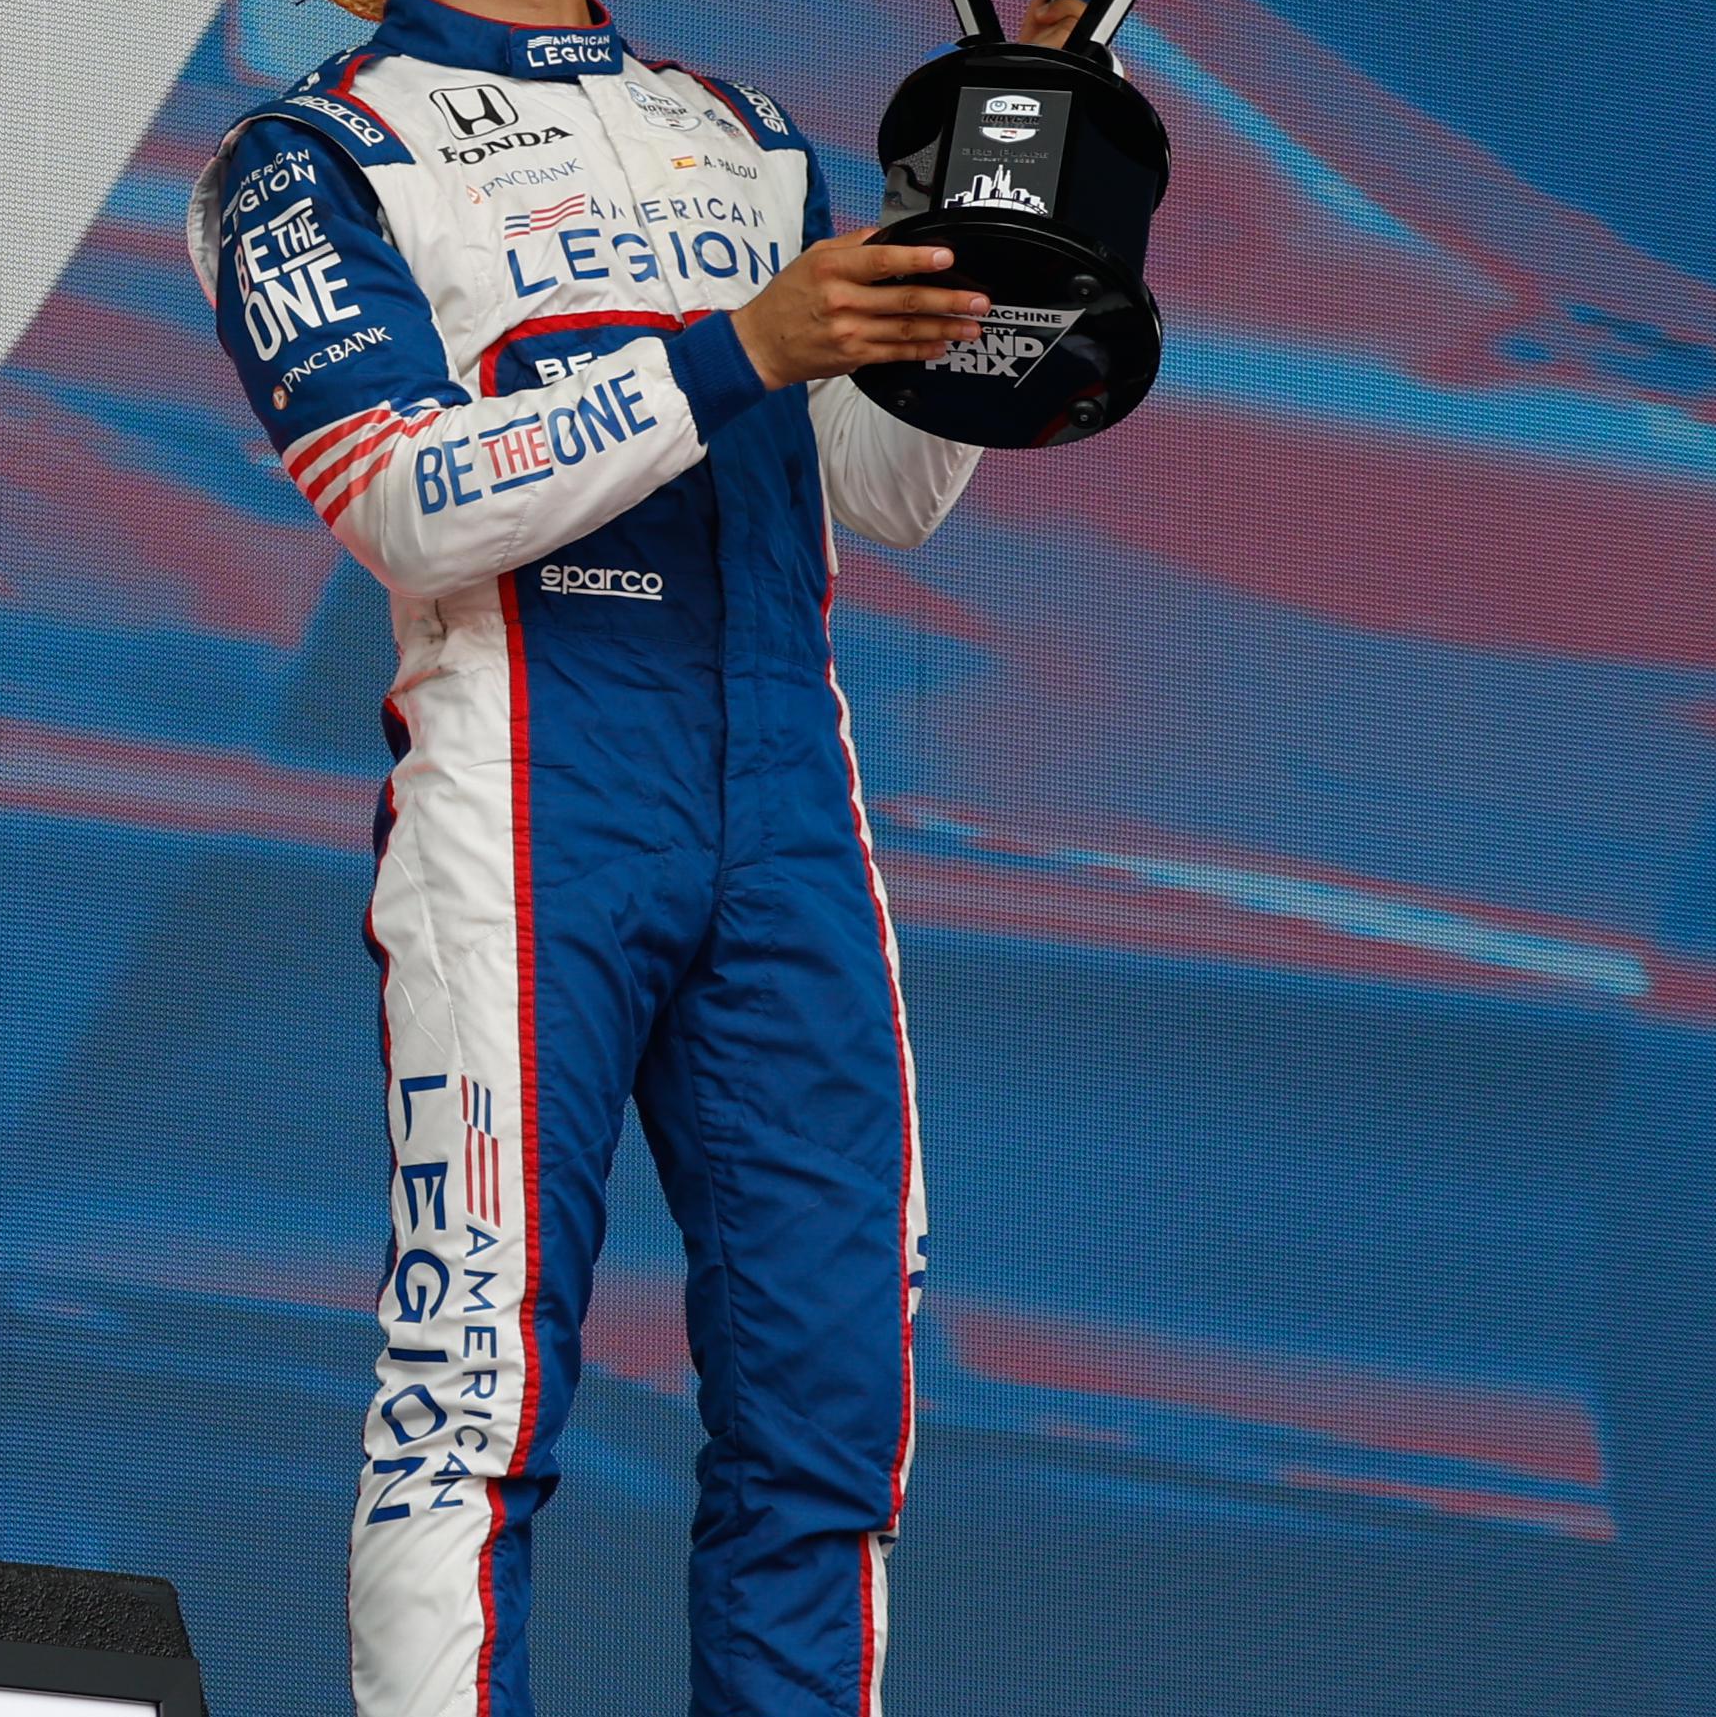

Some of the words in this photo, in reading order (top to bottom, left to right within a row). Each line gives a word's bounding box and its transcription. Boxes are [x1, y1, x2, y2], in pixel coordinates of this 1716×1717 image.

[552, 34, 611, 45] AMERICAN
[1010, 103, 1038, 111] NTT
[437, 126, 574, 165] HONDA
[703, 155, 716, 168] A.
[234, 224, 281, 305] BE
[271, 208, 327, 259] THE
[506, 227, 780, 299] LEGION
[244, 251, 362, 362] ONE
[981, 309, 1063, 324] ACHINE
[982, 326, 1017, 335] CITY
[415, 435, 484, 516] BE
[481, 424, 551, 480] THE
[547, 368, 658, 466] ONE
[540, 563, 664, 598] sparco
[367, 1072, 449, 1526] LEGION
[433, 1227, 500, 1510] AMERICAN
